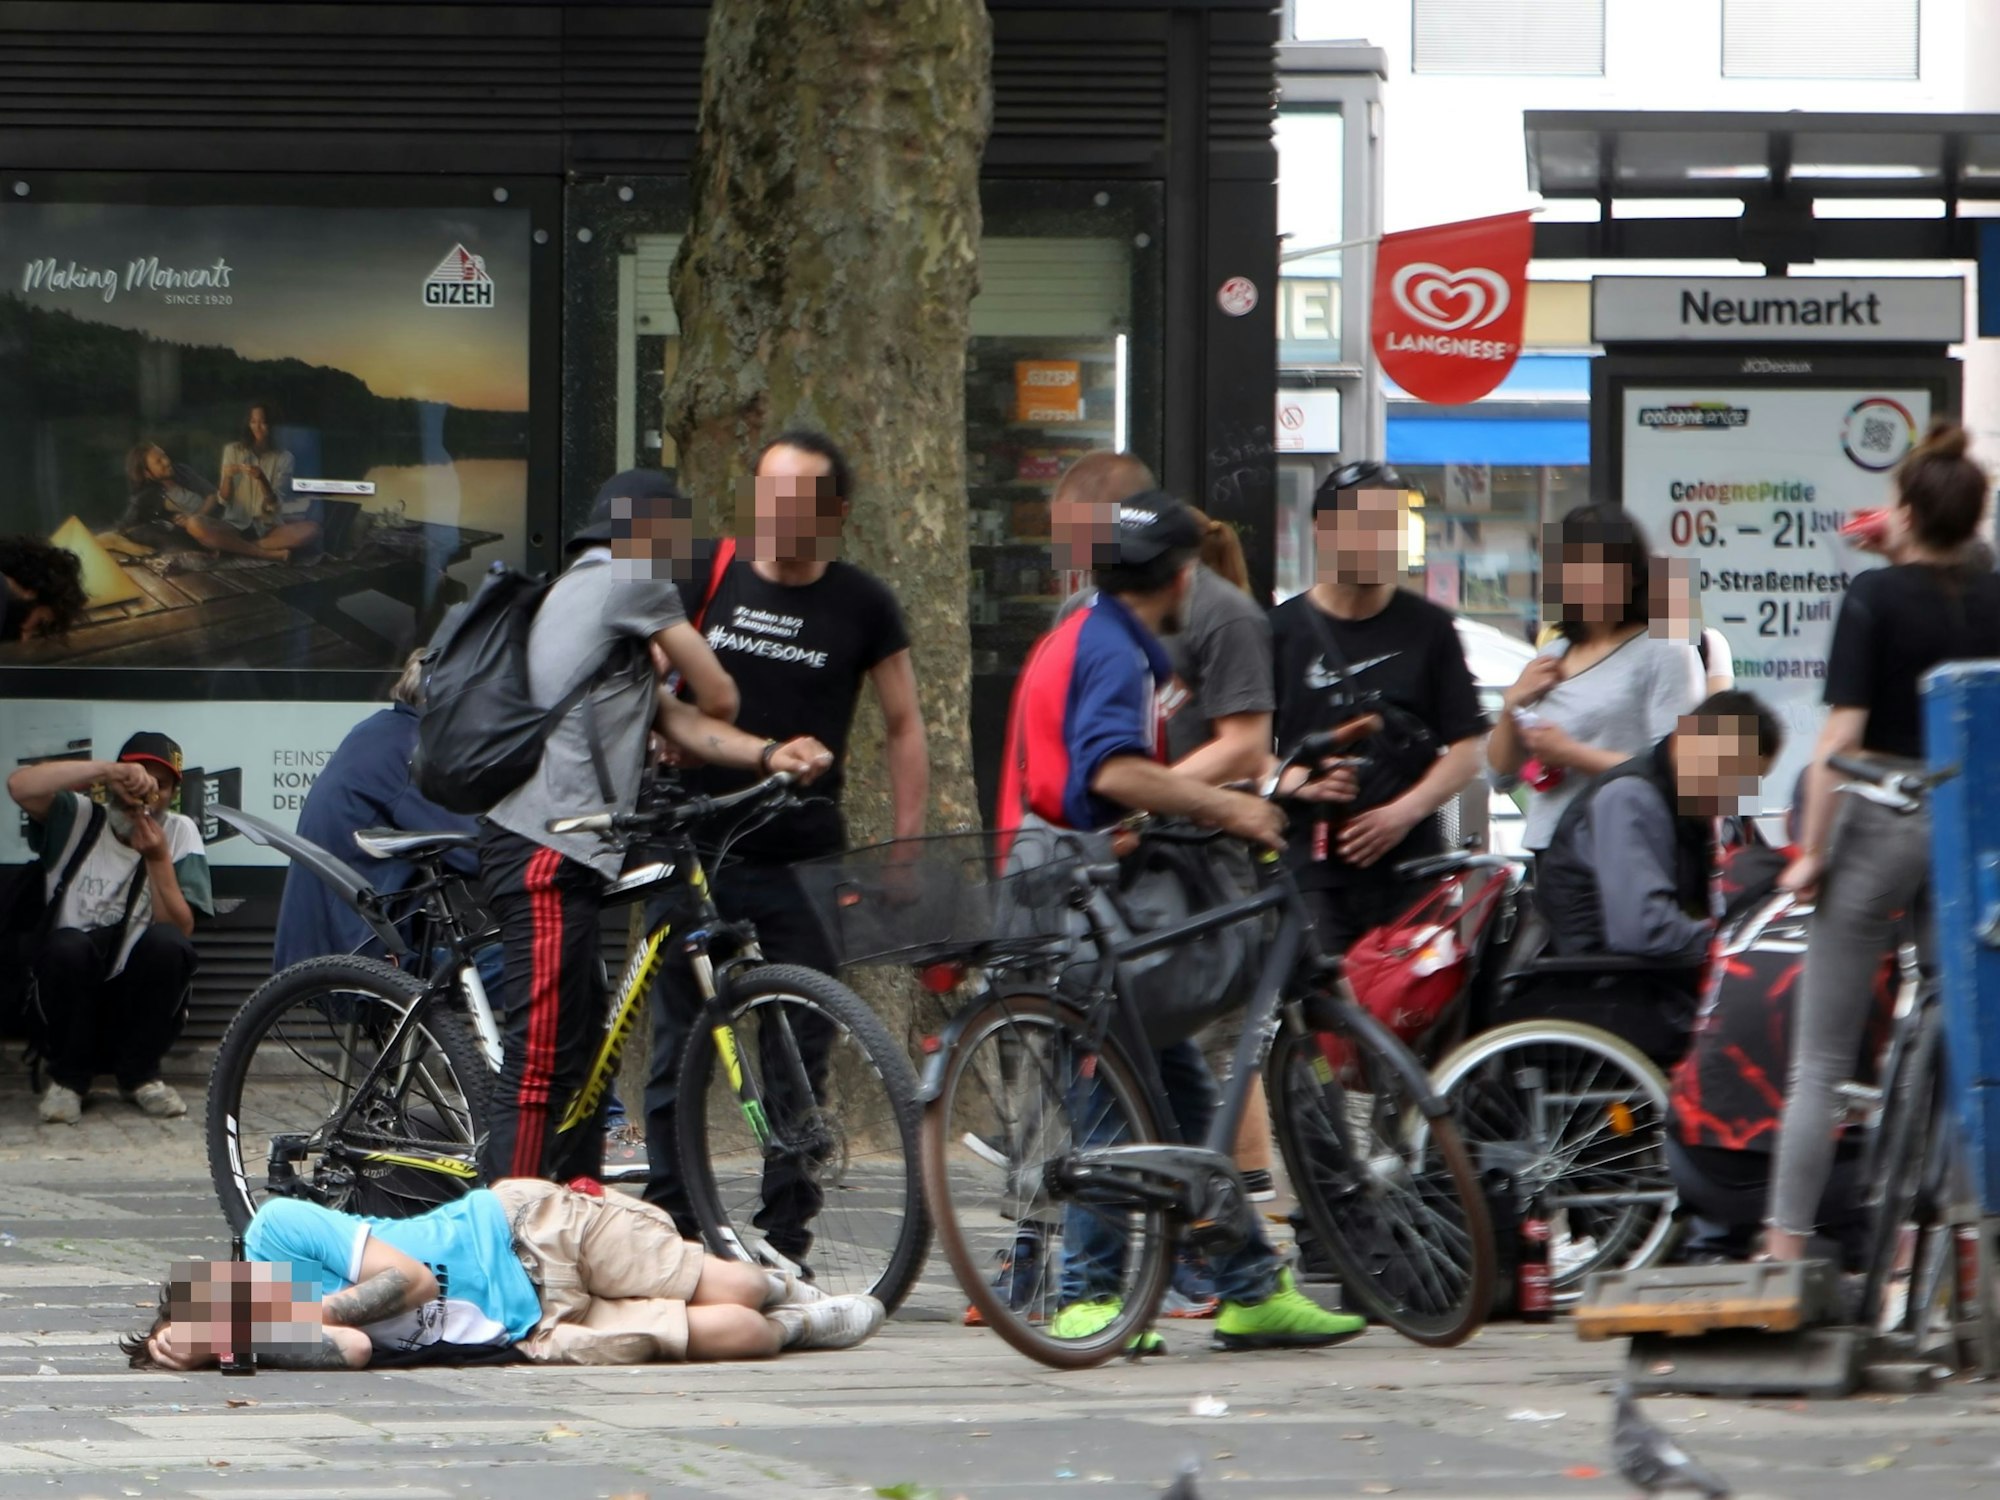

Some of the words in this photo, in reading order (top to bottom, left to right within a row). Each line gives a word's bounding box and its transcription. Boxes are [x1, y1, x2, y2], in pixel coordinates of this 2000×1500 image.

[21, 257, 118, 303] Making
[123, 256, 233, 292] Moments
[425, 283, 492, 305] GIZEH
[165, 295, 201, 305] SINCE
[205, 295, 233, 305] 1920
[1680, 289, 1880, 325] Neumarkt
[1385, 331, 1507, 361] LANGNESE
[1670, 482, 1816, 504] ColognePride
[1671, 509, 1726, 548] 06.
[1773, 510, 1816, 548] 21.
[1700, 570, 1851, 593] D-Straßenfest
[1759, 600, 1801, 638] 21.
[1797, 600, 1832, 621] Juli
[707, 624, 829, 669] #AWESOME
[1732, 659, 1826, 681] emopara
